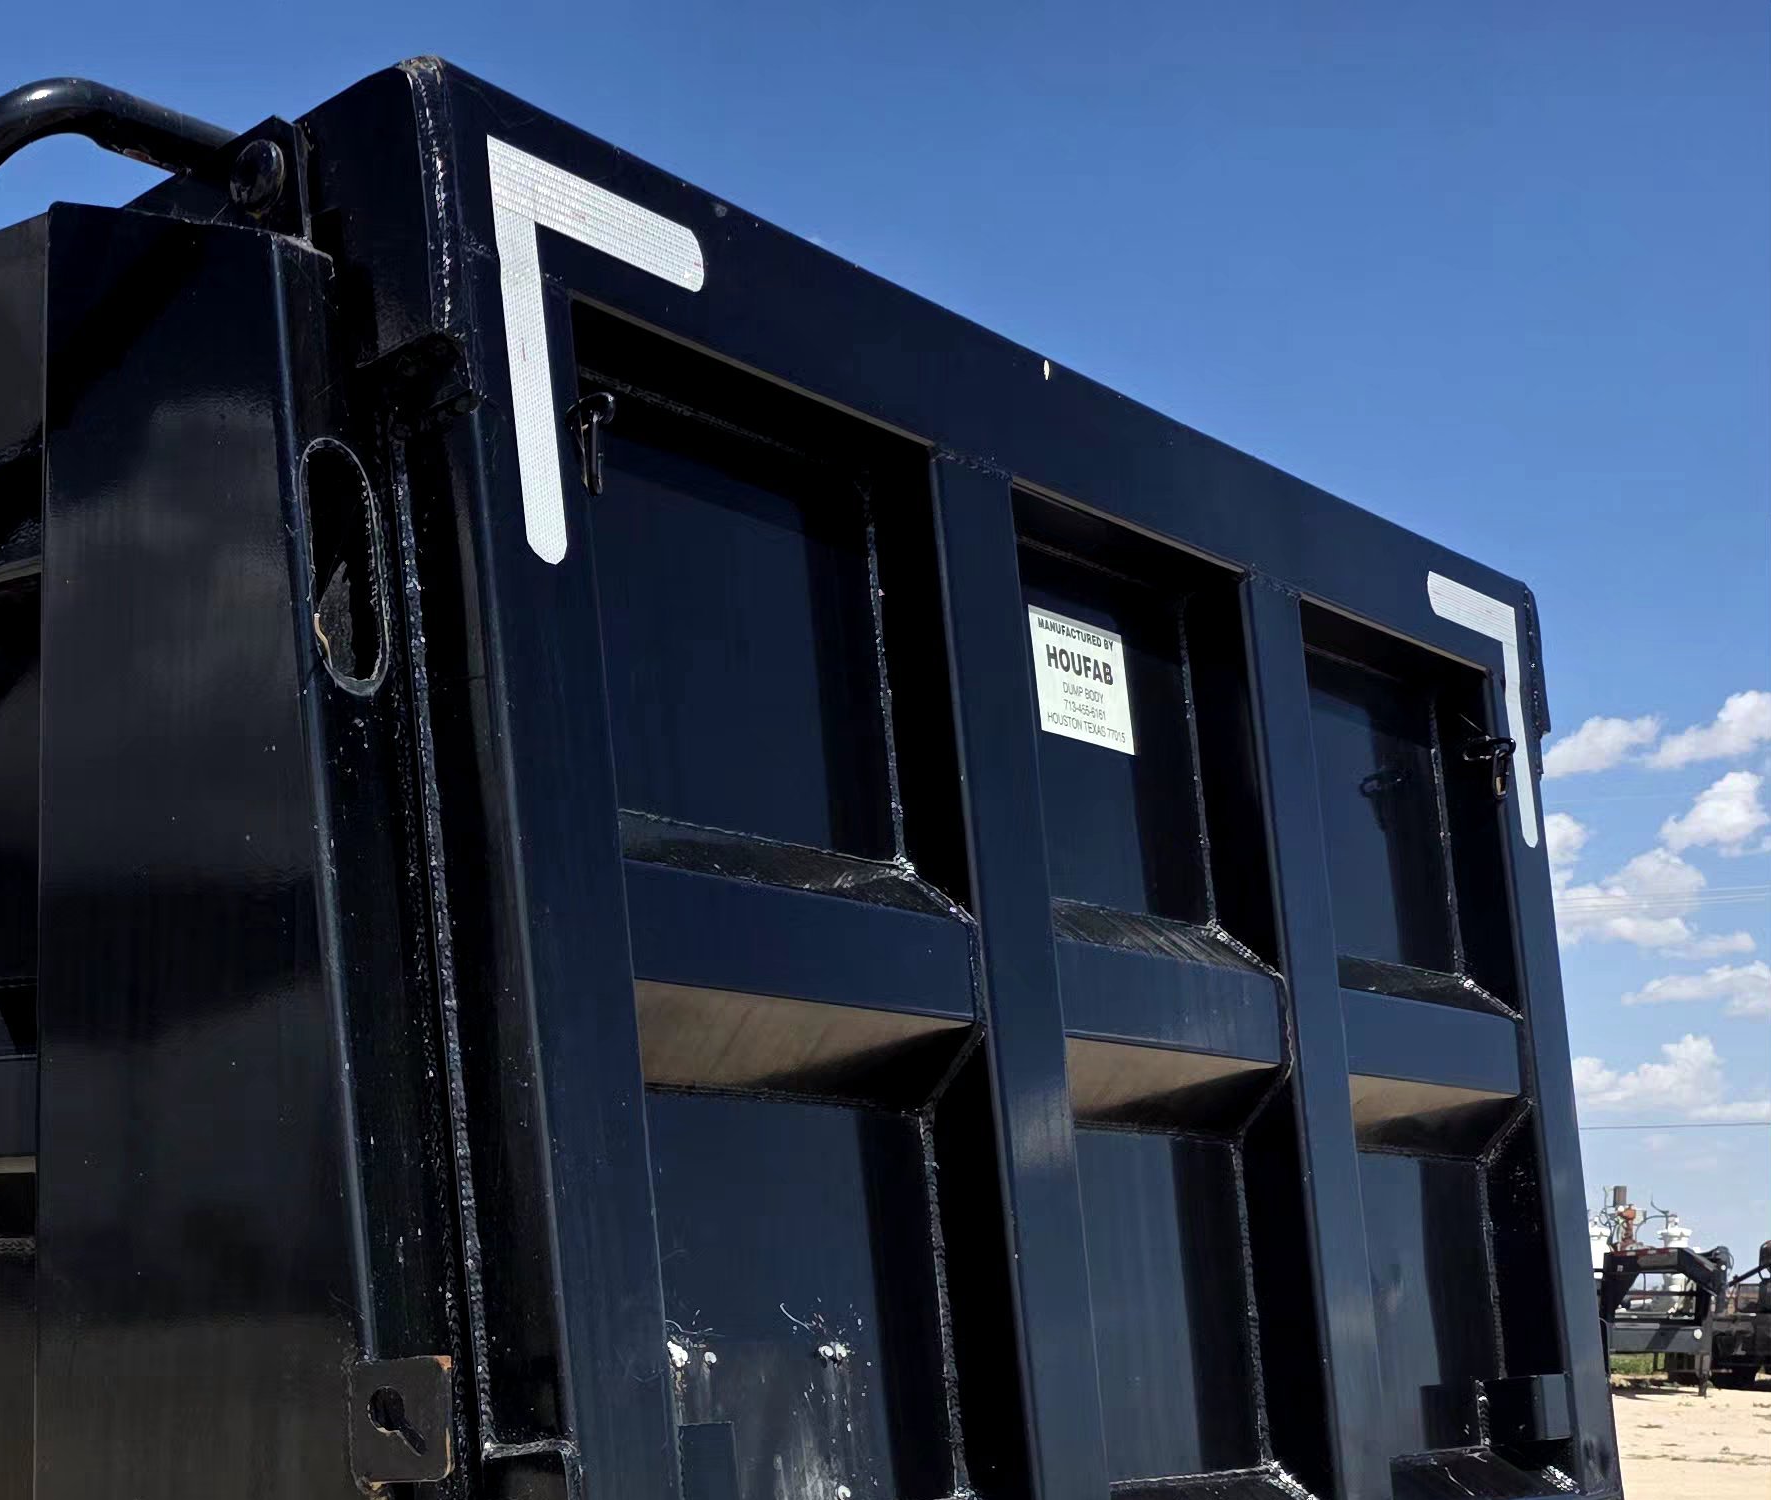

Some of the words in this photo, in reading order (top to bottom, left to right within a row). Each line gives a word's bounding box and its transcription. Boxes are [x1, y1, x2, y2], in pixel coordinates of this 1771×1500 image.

[1037, 617, 1102, 647] MANUFACTURED
[1104, 639, 1114, 651] BY
[1045, 644, 1114, 685] HOUFAB
[1062, 682, 1084, 697] DUMP
[1084, 688, 1104, 704] BODY
[1047, 712, 1083, 730] HOUSTON
[1084, 719, 1107, 737] TEXAS
